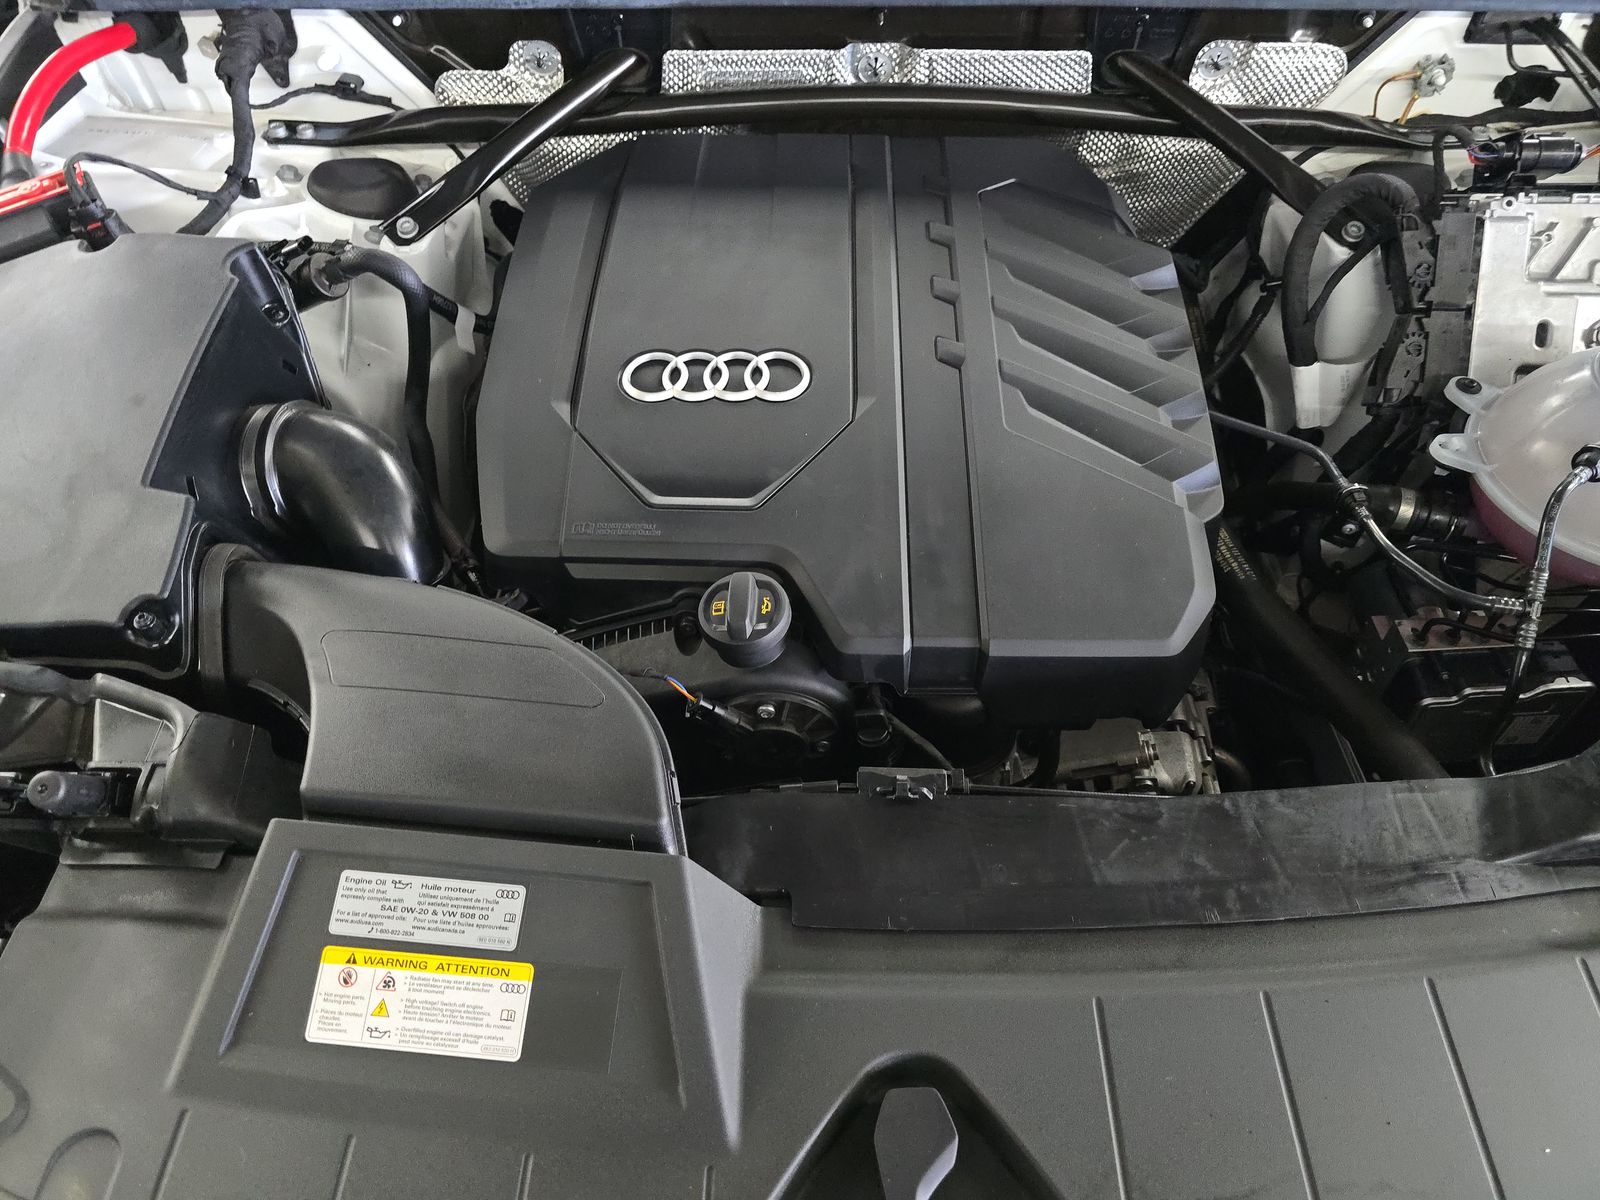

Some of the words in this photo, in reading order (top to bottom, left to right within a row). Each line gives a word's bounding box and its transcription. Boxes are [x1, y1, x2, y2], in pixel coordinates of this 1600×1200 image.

[344, 875, 373, 885] Engine
[420, 882, 442, 890] Huile
[444, 885, 476, 894] moteur
[439, 894, 472, 902] uniquement
[400, 906, 428, 915] 0W-20
[362, 955, 428, 970] WARNING
[435, 962, 510, 976] ATTENTION
